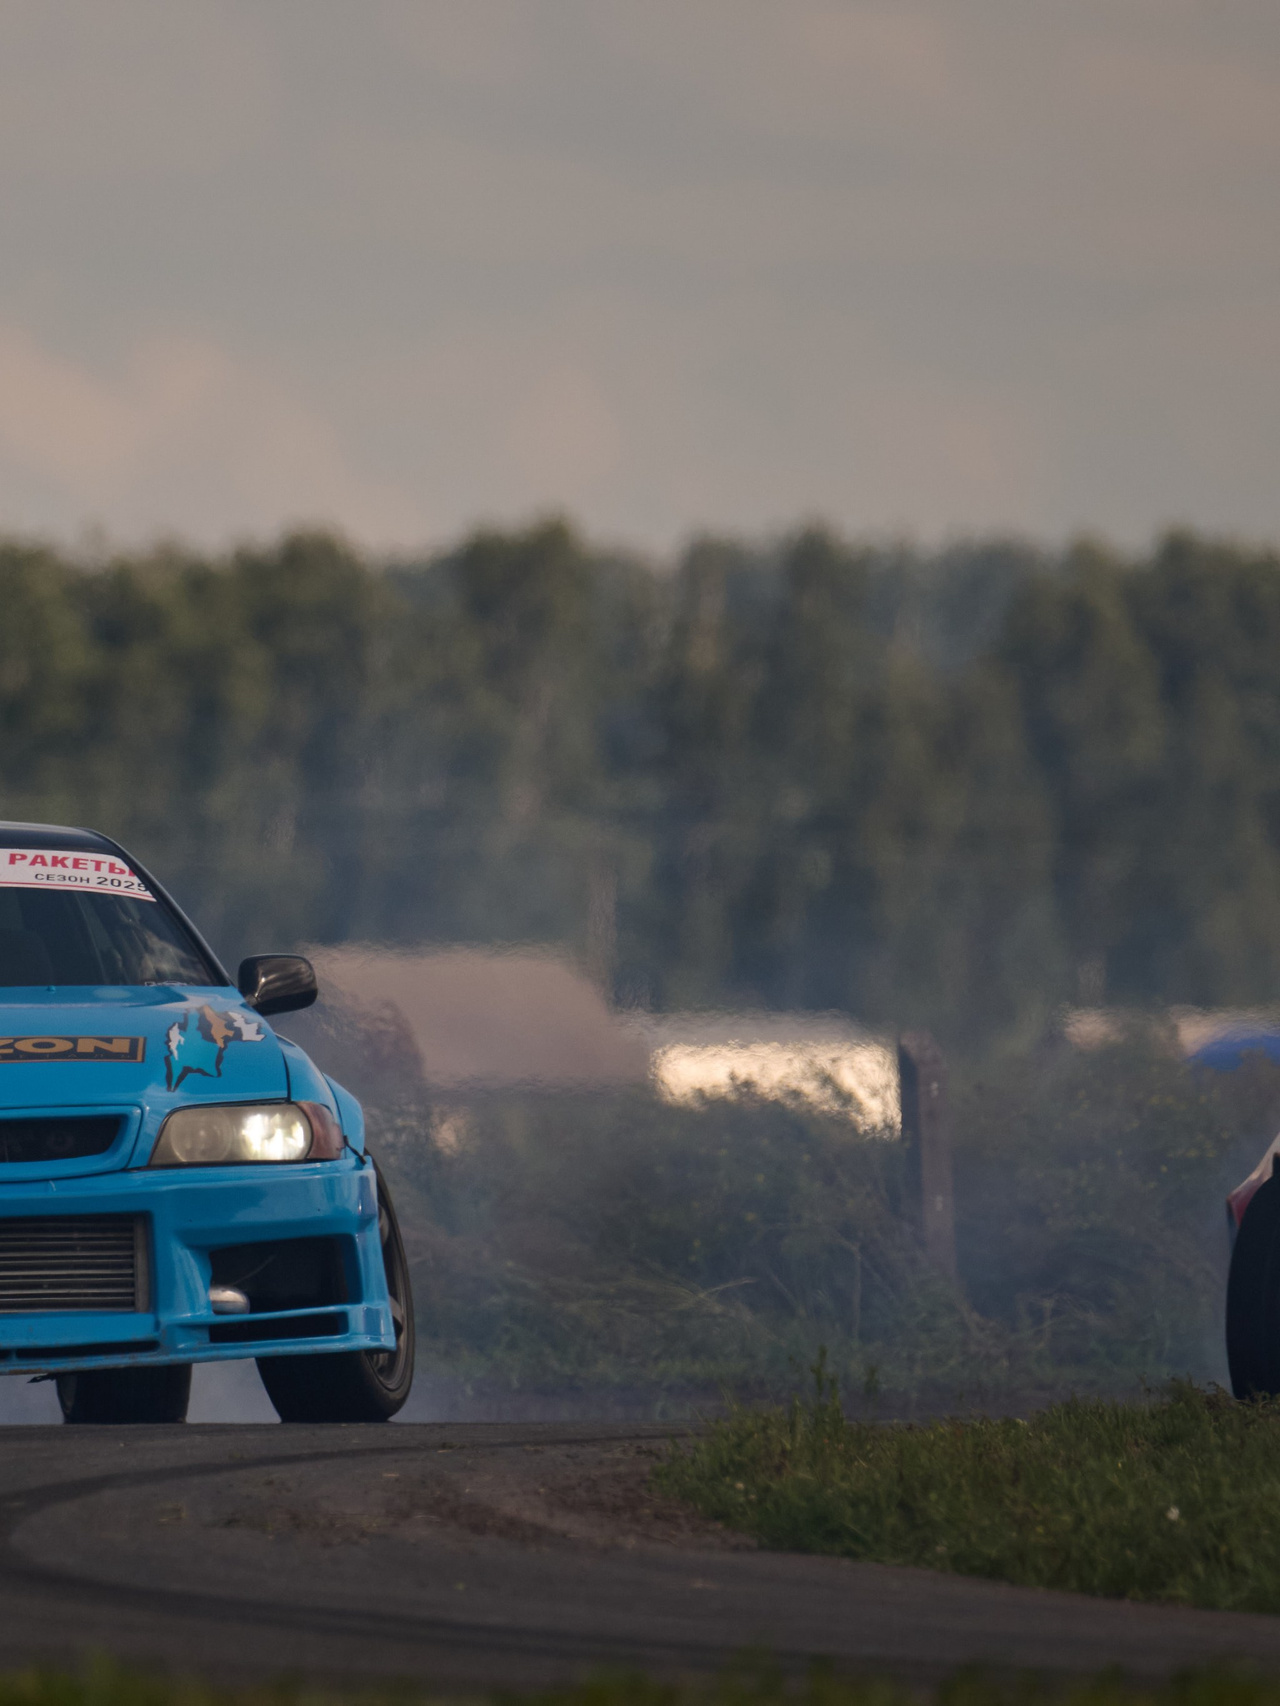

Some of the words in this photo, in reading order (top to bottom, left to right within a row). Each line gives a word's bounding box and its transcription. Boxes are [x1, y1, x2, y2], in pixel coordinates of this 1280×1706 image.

[8, 853, 137, 877] РАКЕТЫ
[34, 872, 90, 884] СЕЗОН
[96, 876, 149, 892] 2025
